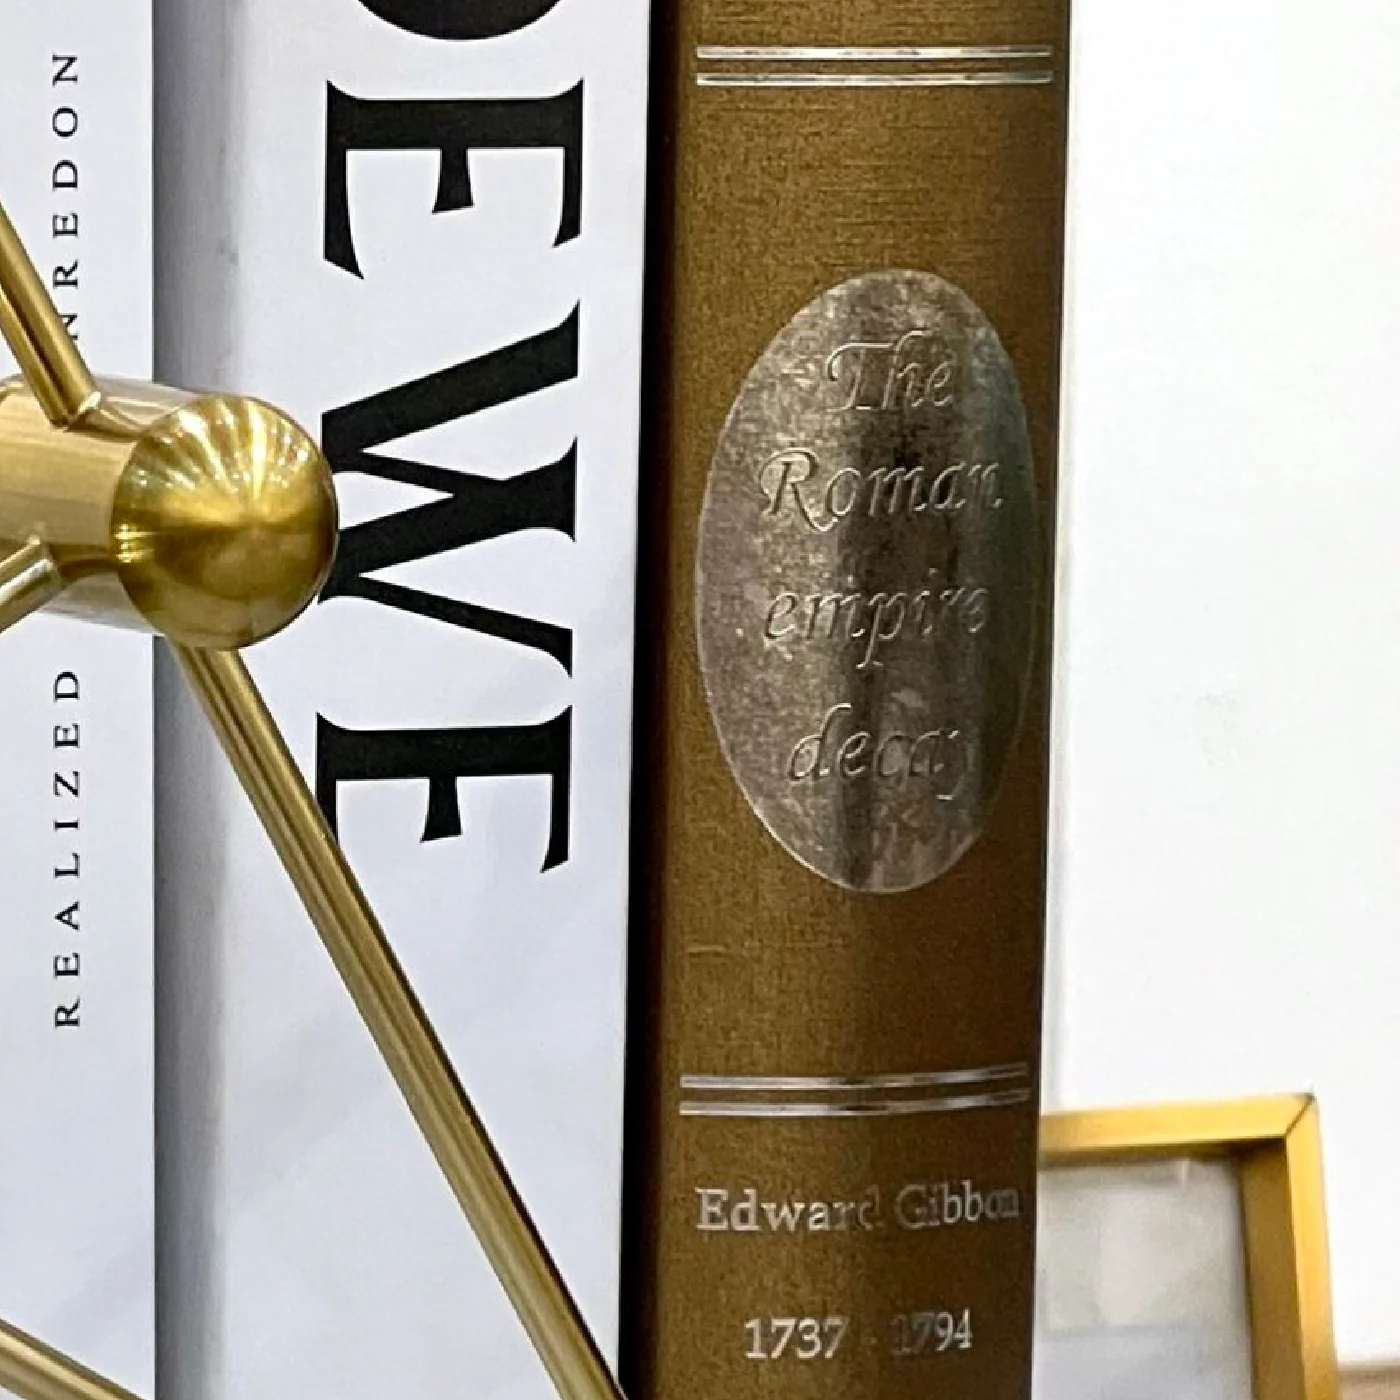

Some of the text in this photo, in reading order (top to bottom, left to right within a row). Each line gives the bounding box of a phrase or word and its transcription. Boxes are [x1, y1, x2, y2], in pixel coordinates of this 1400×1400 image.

[826, 331, 955, 411] The
[757, 448, 1004, 533] Roman
[763, 568, 992, 669] empire
[53, 670, 80, 1027] REALIZED
[694, 1180, 1019, 1231] Edward Gibbon
[744, 1314, 849, 1360] 1737
[890, 1308, 974, 1357] 1794
